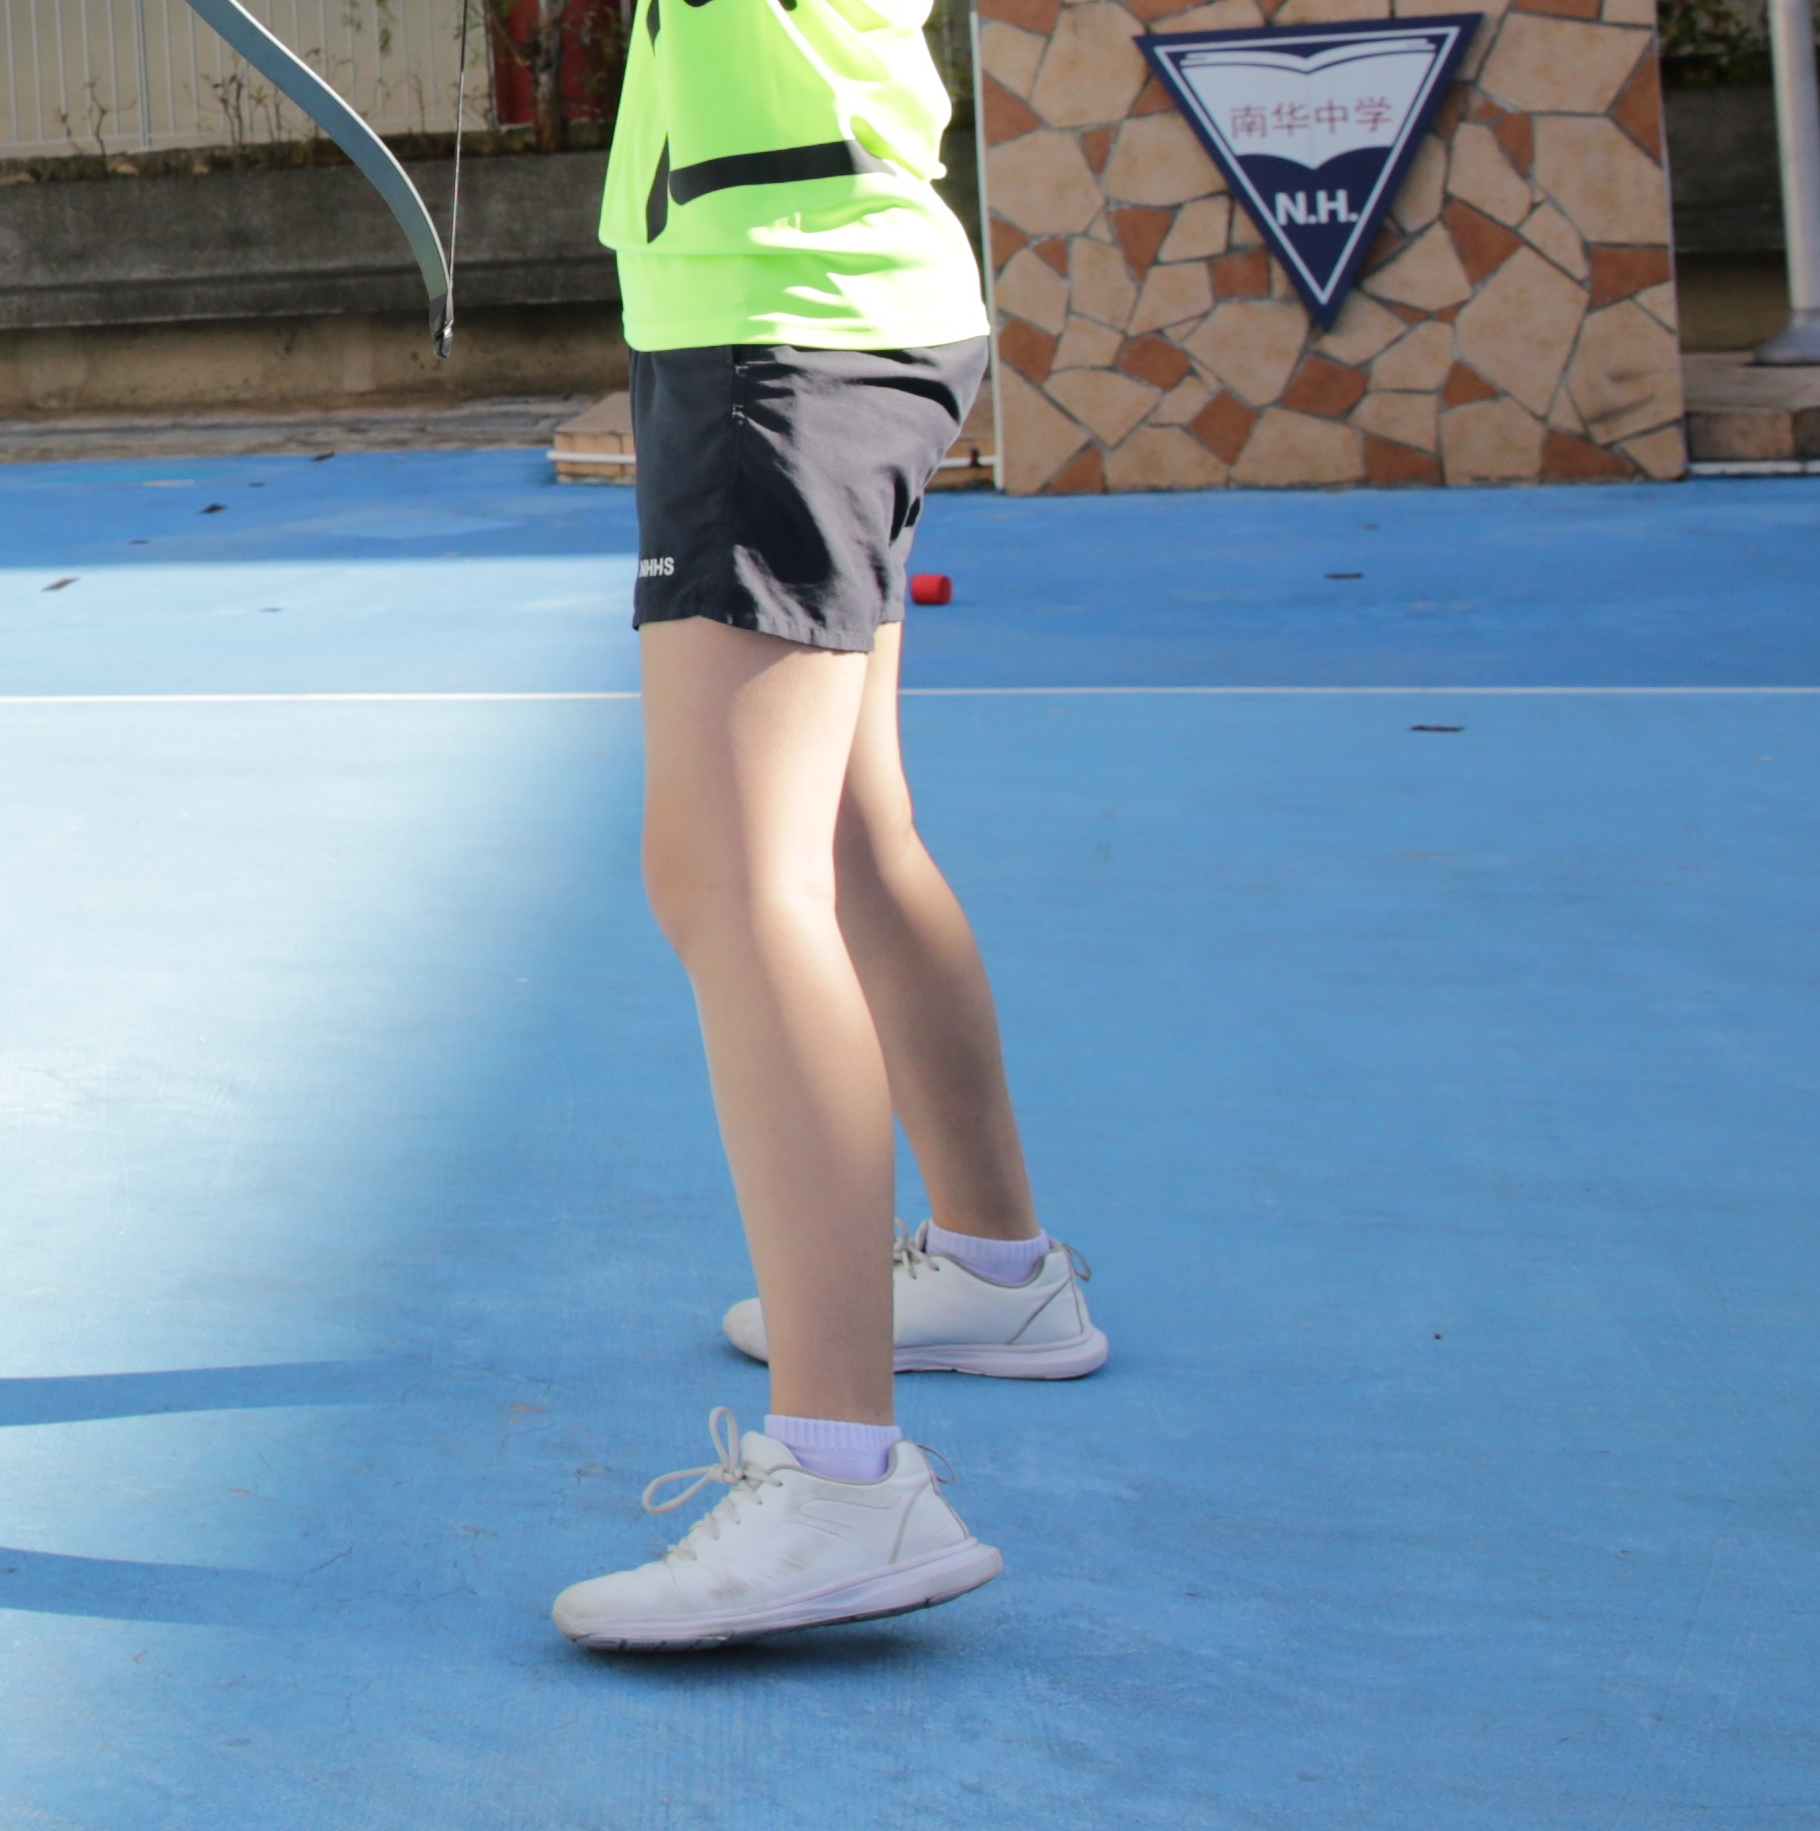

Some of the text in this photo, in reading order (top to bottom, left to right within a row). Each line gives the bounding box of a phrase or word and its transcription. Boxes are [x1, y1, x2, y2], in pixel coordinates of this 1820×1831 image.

[1229, 96, 1392, 140] 南华中学
[1275, 189, 1360, 226] N.H.
[639, 556, 675, 578] NHHS
